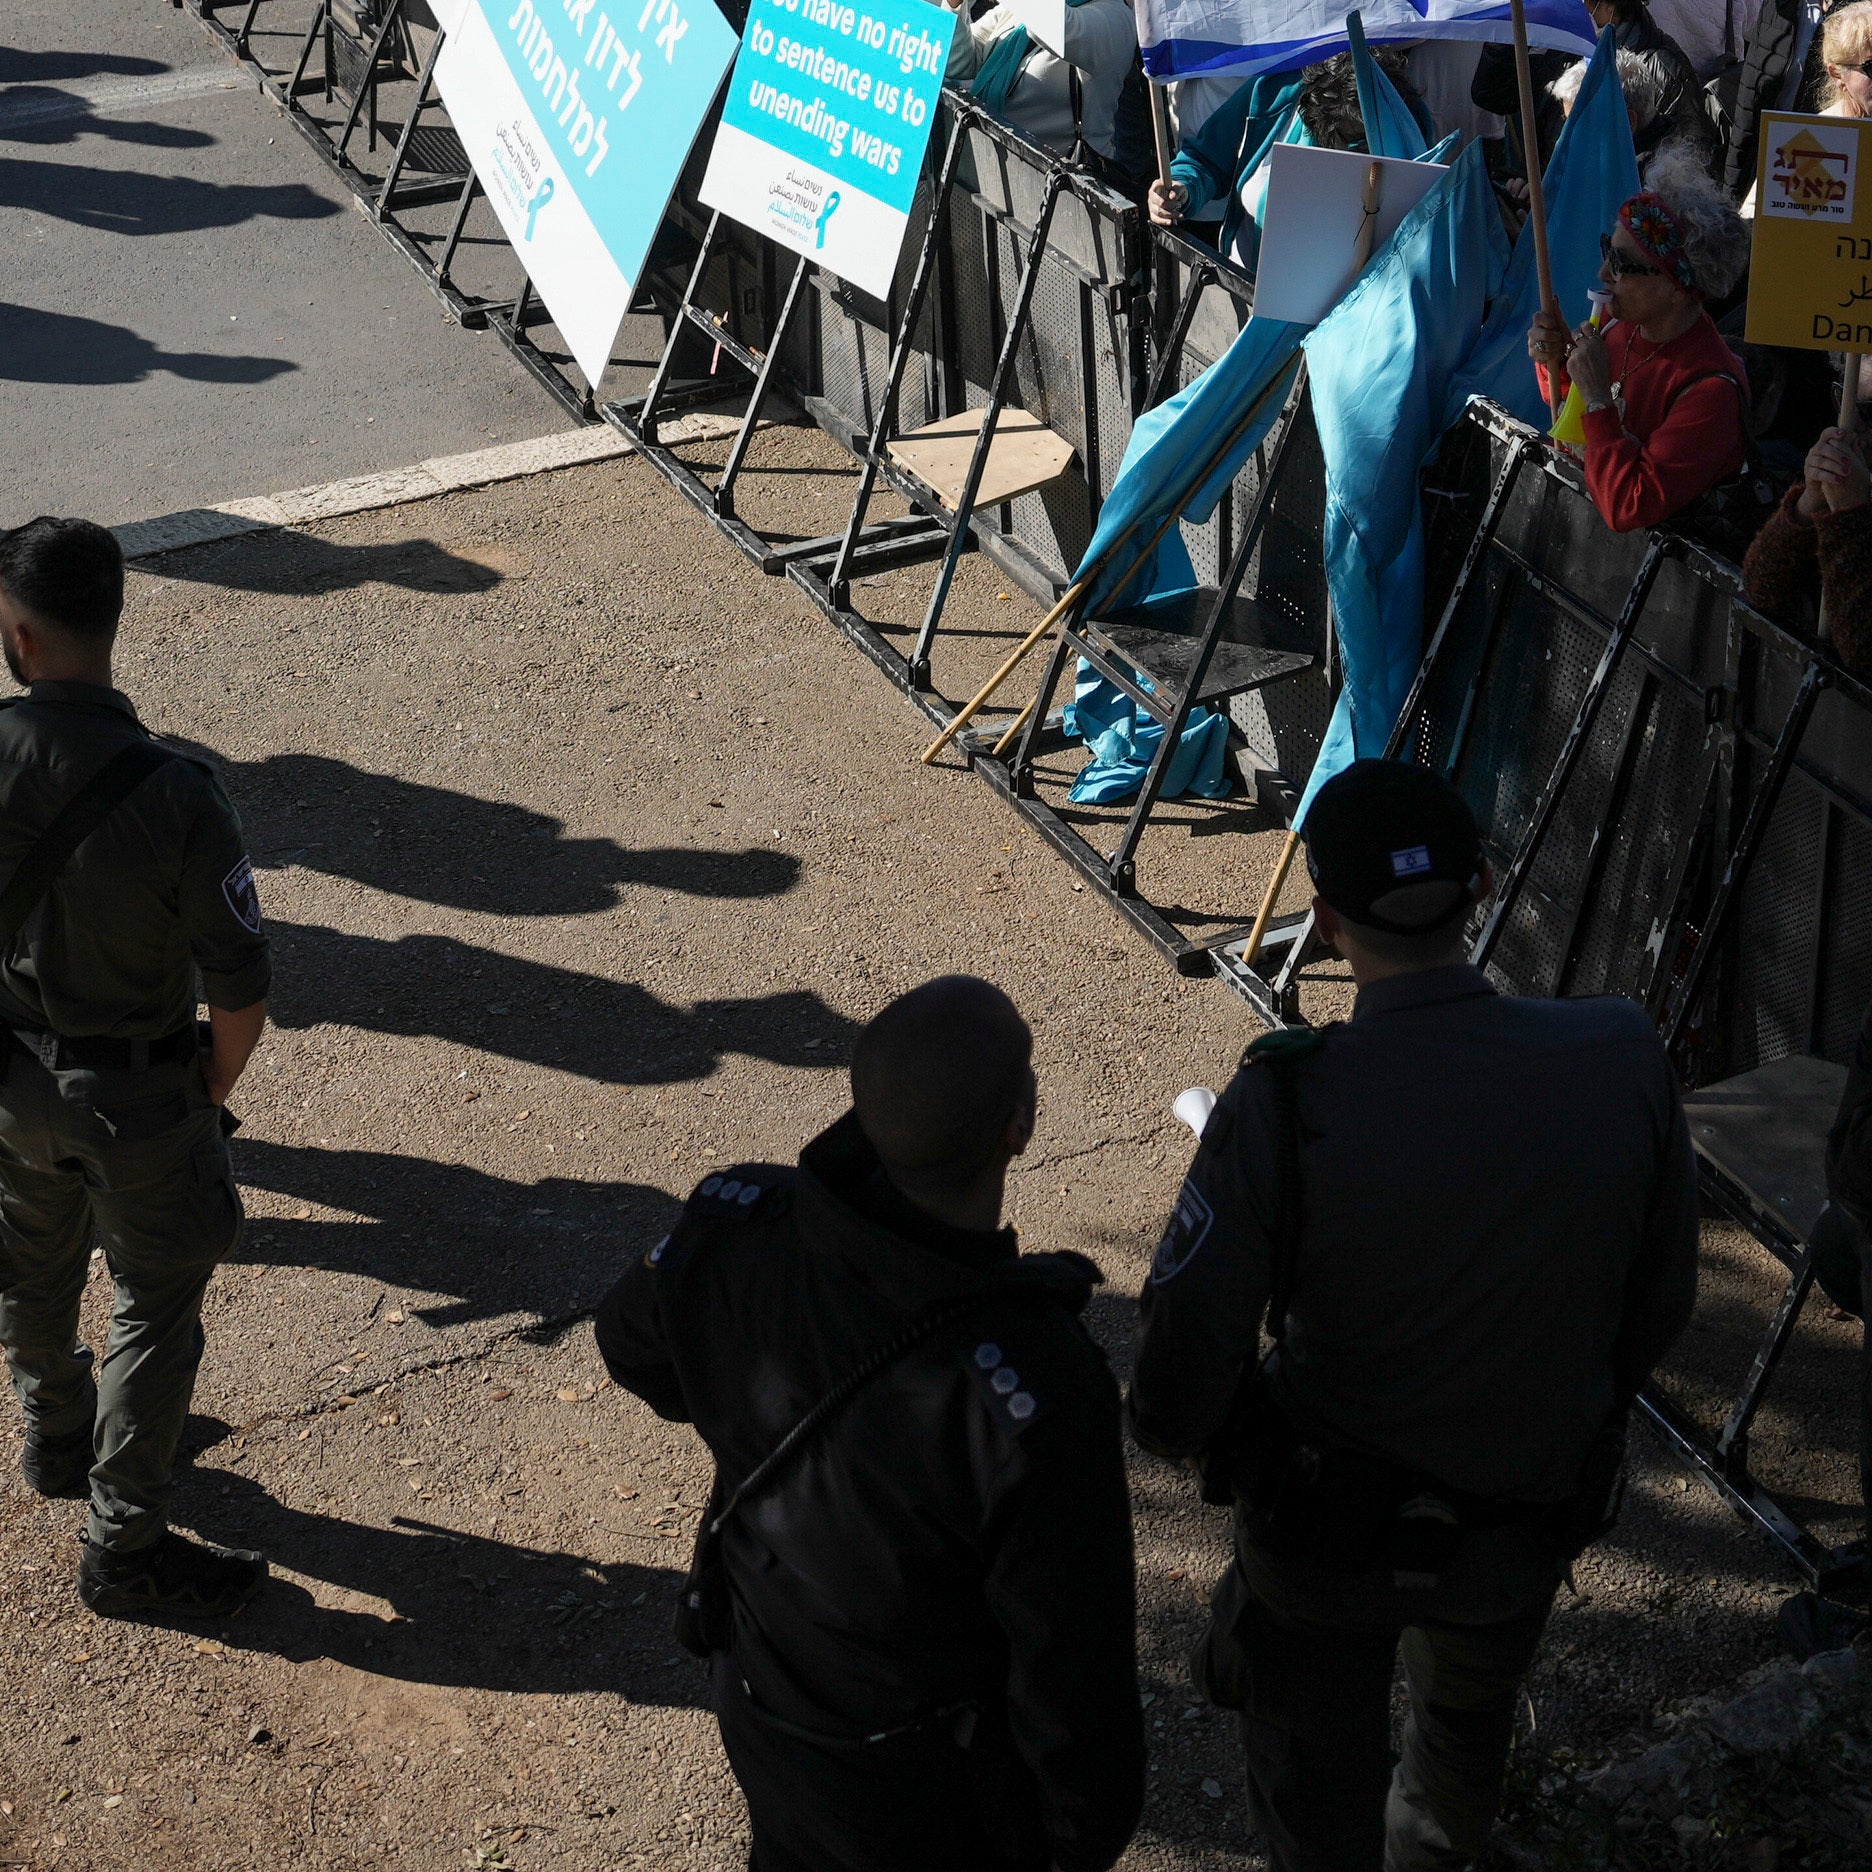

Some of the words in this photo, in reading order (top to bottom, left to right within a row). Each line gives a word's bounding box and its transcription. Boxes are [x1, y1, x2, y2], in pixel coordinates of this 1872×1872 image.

[584, 11, 644, 111] לדון
[750, 18, 775, 57] to
[775, 36, 874, 102] sentence
[873, 79, 900, 115] us
[900, 85, 927, 127] to
[856, 12, 886, 50] no
[887, 22, 943, 76] right
[749, 79, 851, 158] unending
[851, 126, 903, 176] wars
[804, 178, 823, 197] נשים
[1772, 173, 1847, 201] מאיר
